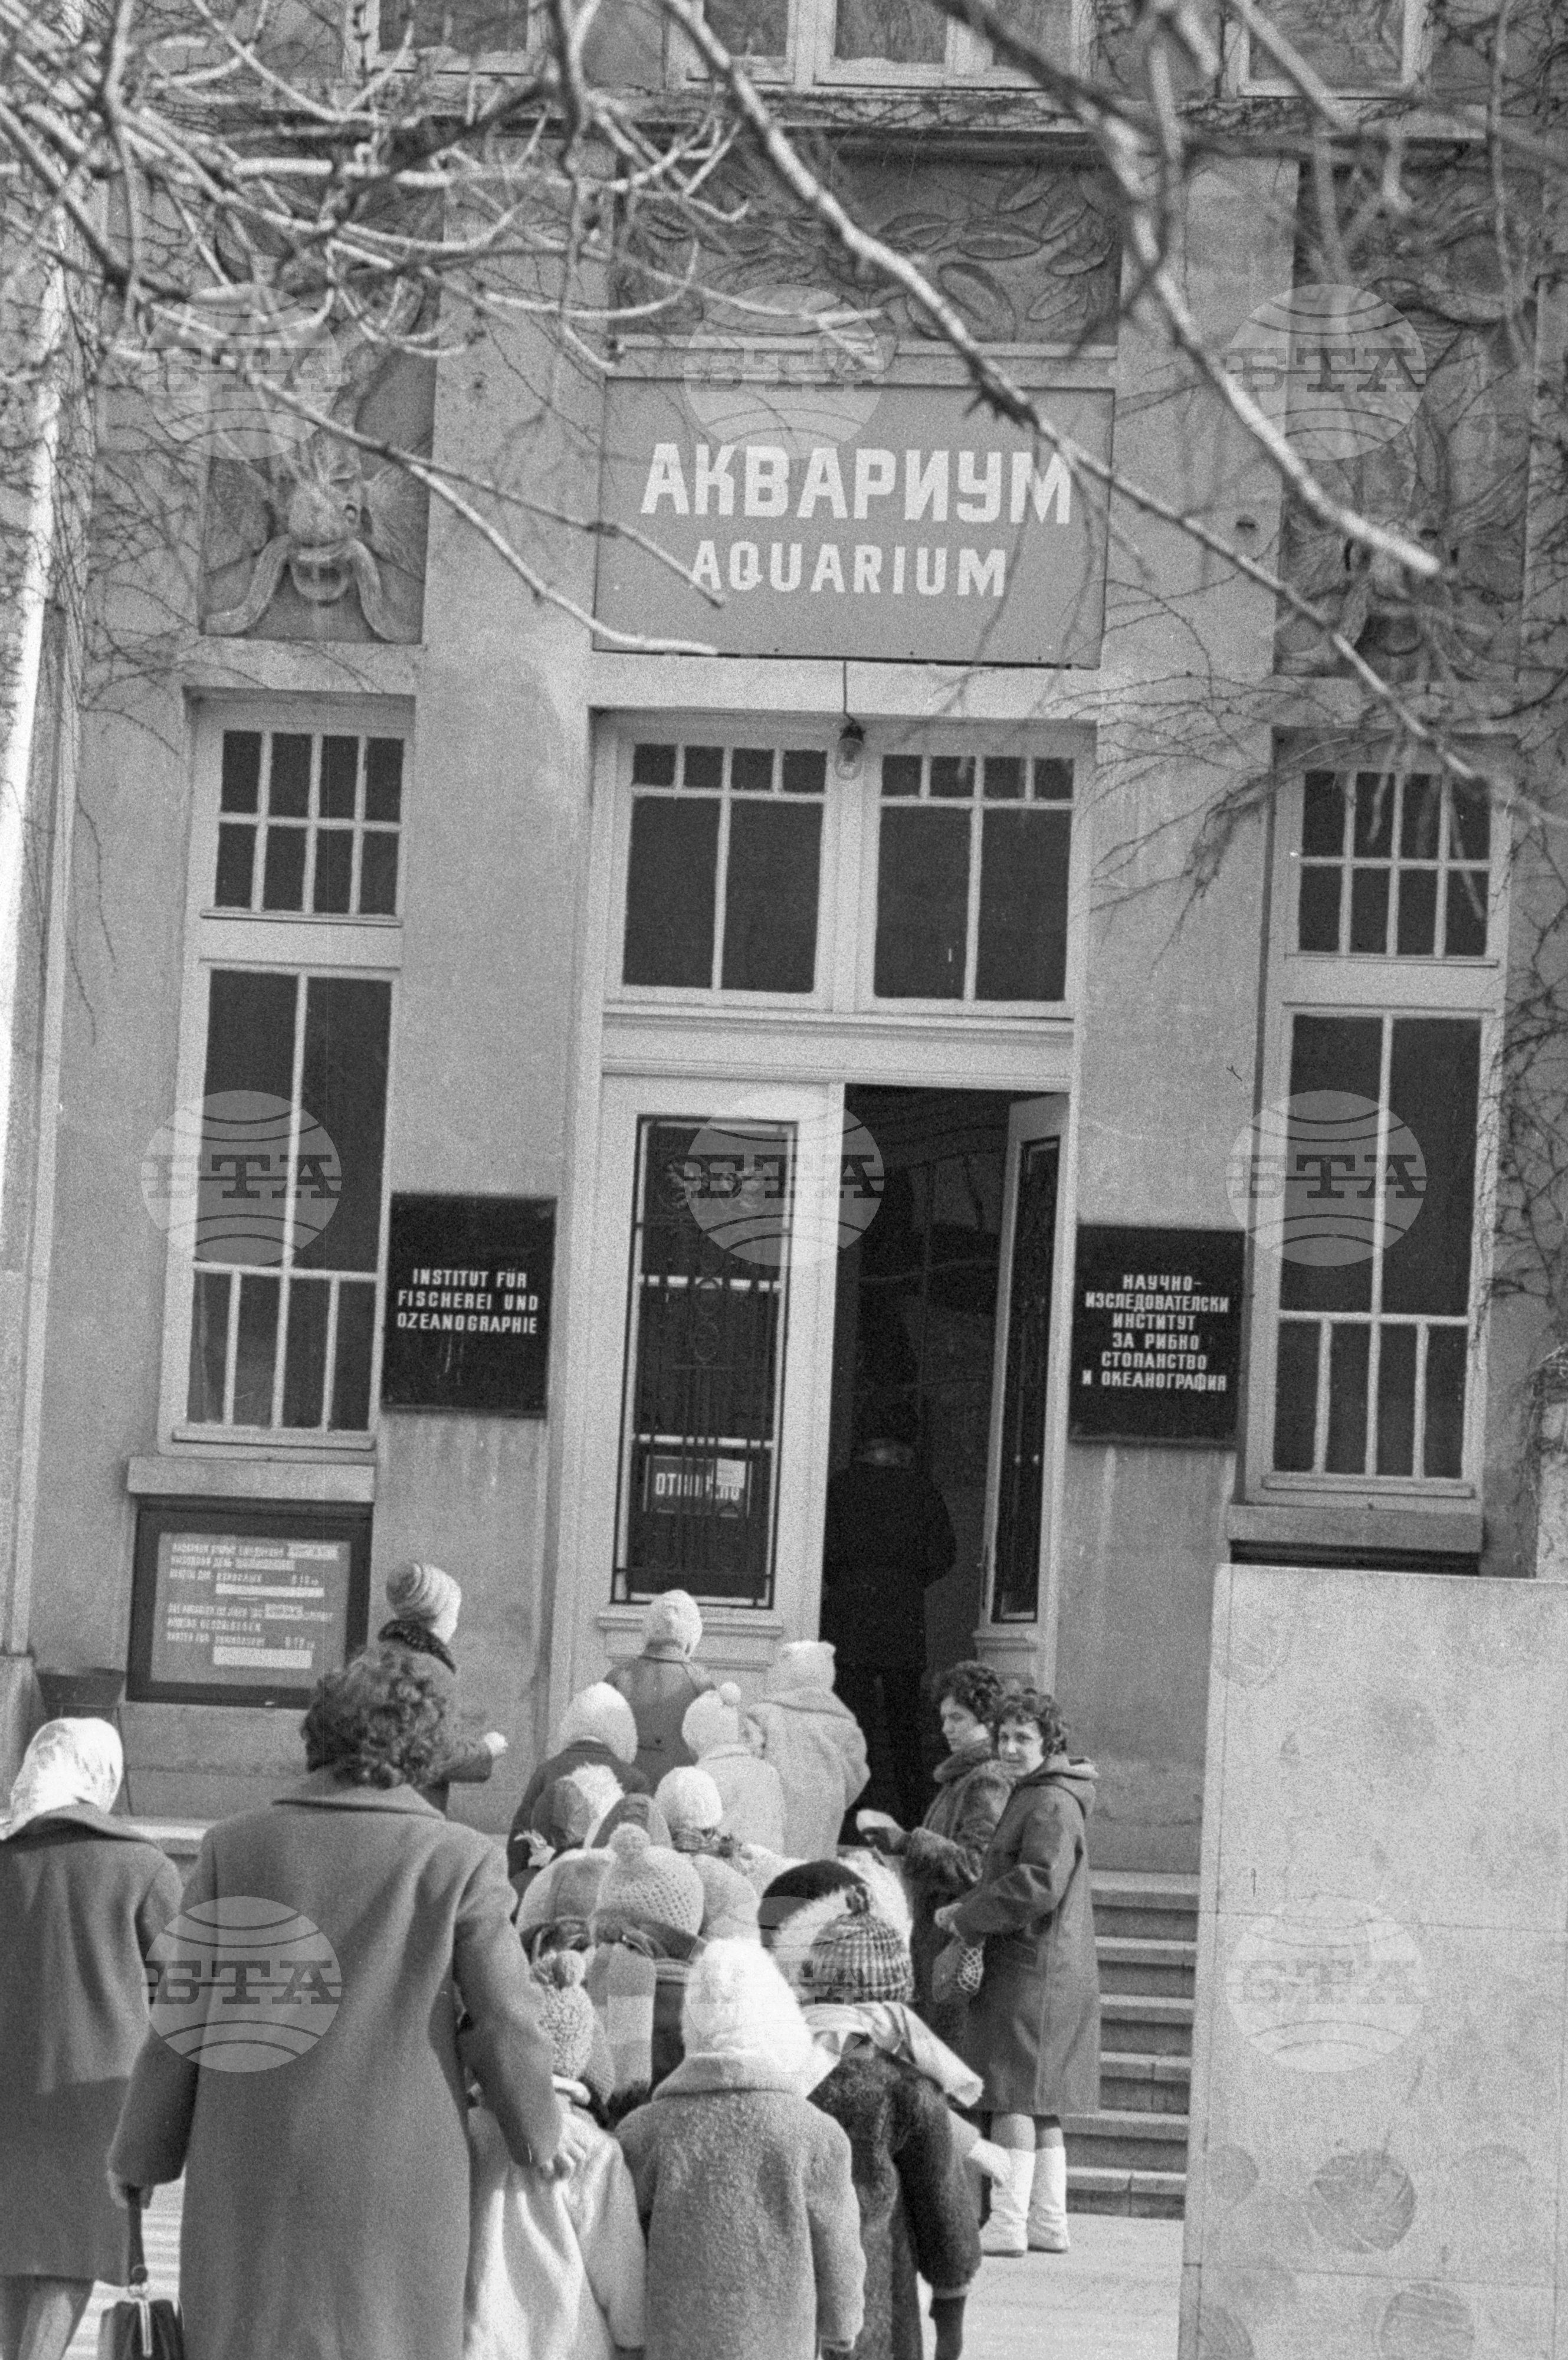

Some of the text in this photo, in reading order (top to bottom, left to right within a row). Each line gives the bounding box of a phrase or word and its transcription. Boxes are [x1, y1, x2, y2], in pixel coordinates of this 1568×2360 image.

[641, 443, 1072, 524] АКВАРИУМ
[691, 540, 1006, 597] AQUARIUM
[414, 1268, 527, 1289] INSTITUT FÜR
[1123, 1274, 1202, 1291] НАУЧНО-
[398, 1290, 539, 1312] FISCHEREI UND
[1084, 1292, 1230, 1313] ИЗСЛЕДОВАТЕЛСКИ
[397, 1312, 538, 1334] OZEANOGRAPHIE
[1113, 1313, 1197, 1330] ИНСТИТУТ
[1112, 1332, 1200, 1351] ЗА РИБНО
[1101, 1352, 1208, 1370] СТОПАНСТВО
[1081, 1370, 1227, 1392] И ОКЕАНОГРАФИЯ
